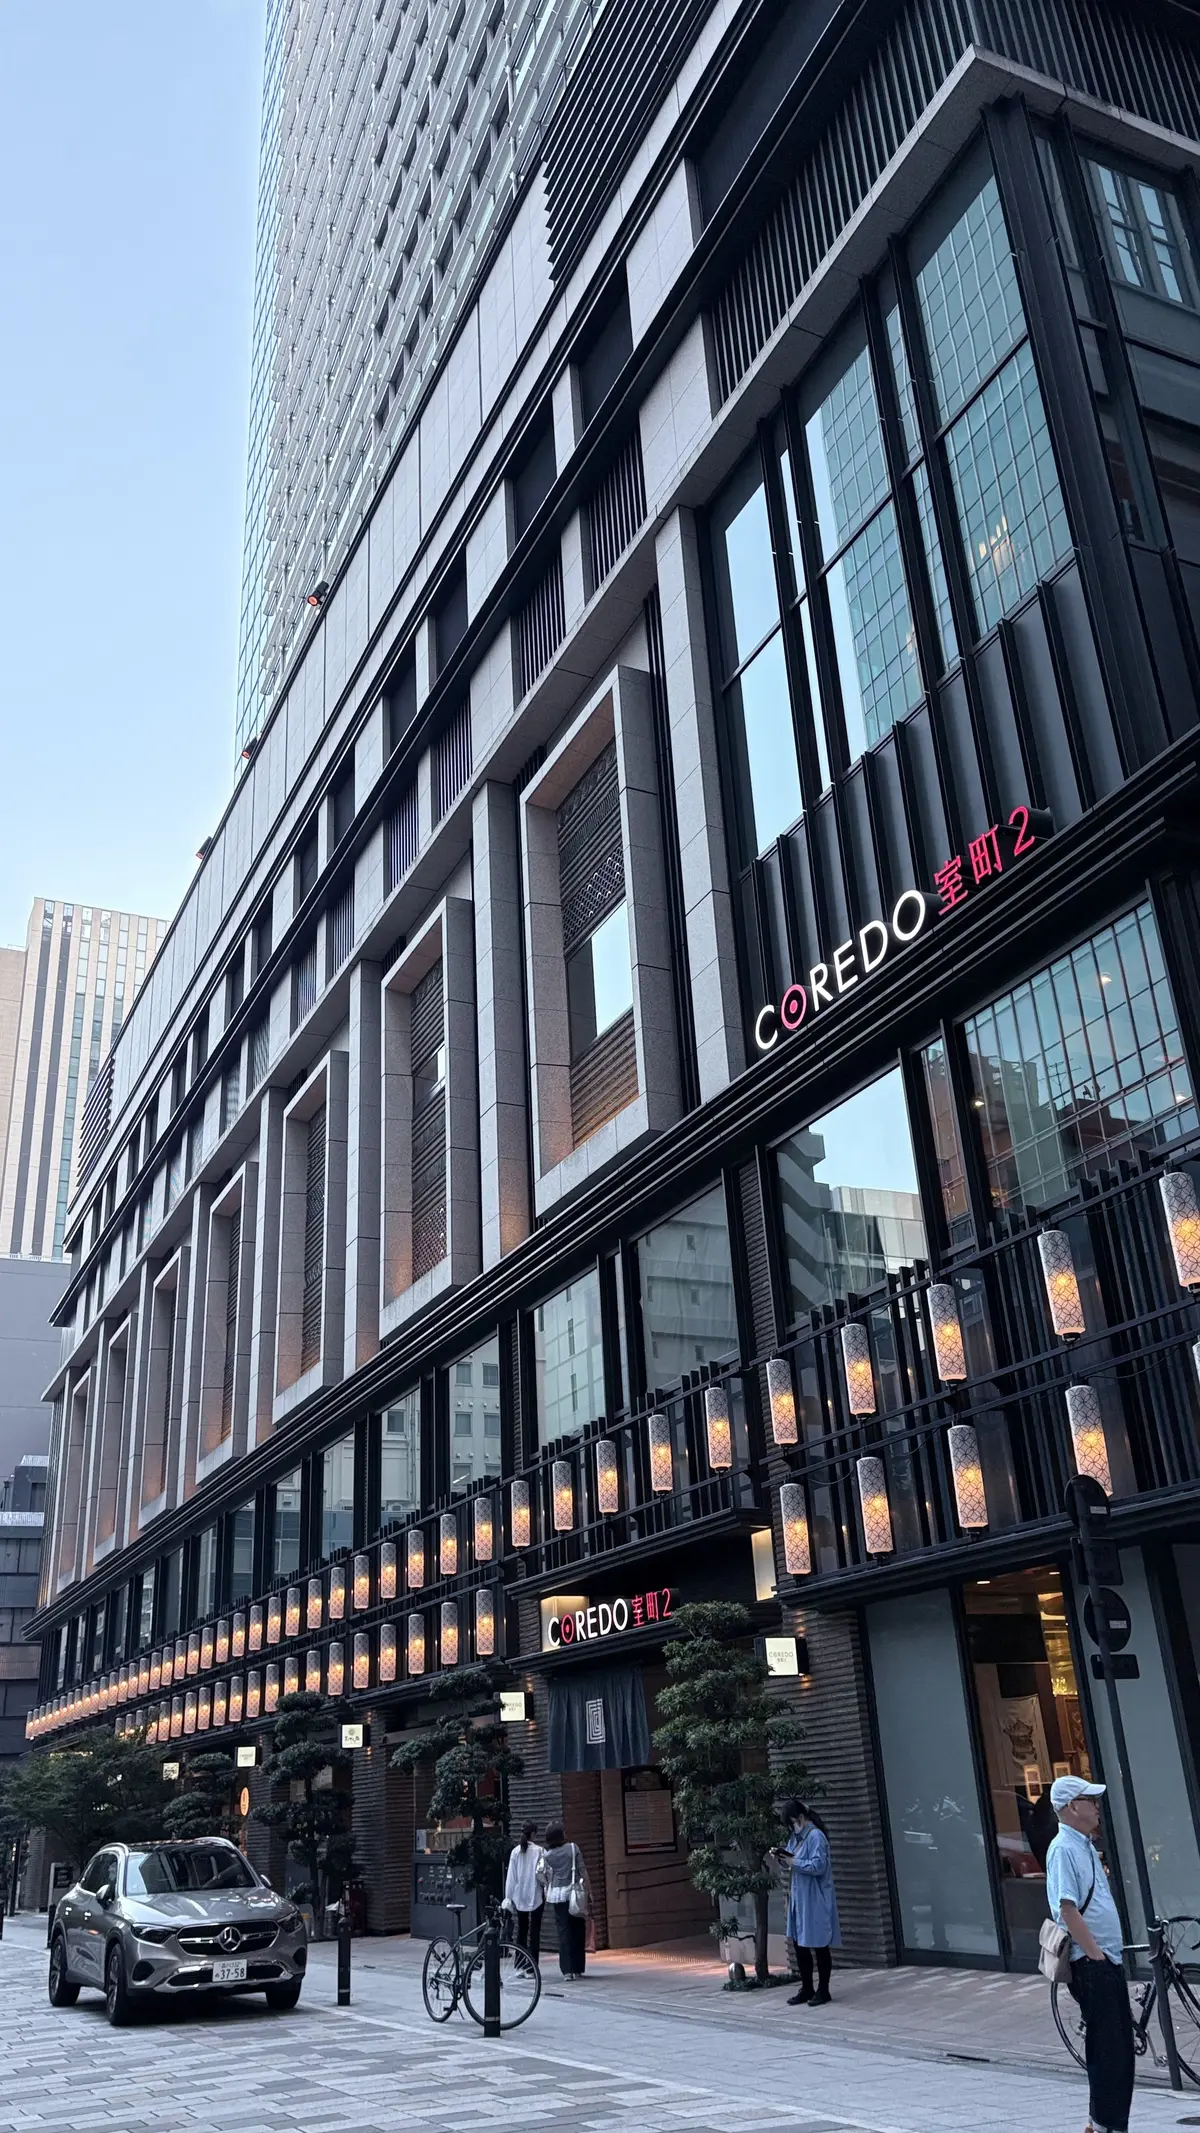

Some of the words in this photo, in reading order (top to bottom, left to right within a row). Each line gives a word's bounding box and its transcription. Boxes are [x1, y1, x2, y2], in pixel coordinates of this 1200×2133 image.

[755, 889, 926, 1050] COREDO
[933, 805, 1036, 915] 室町2
[548, 1598, 628, 1647] COREDO
[631, 1588, 672, 1627] 室町2
[220, 1968, 245, 1980] 37-58
